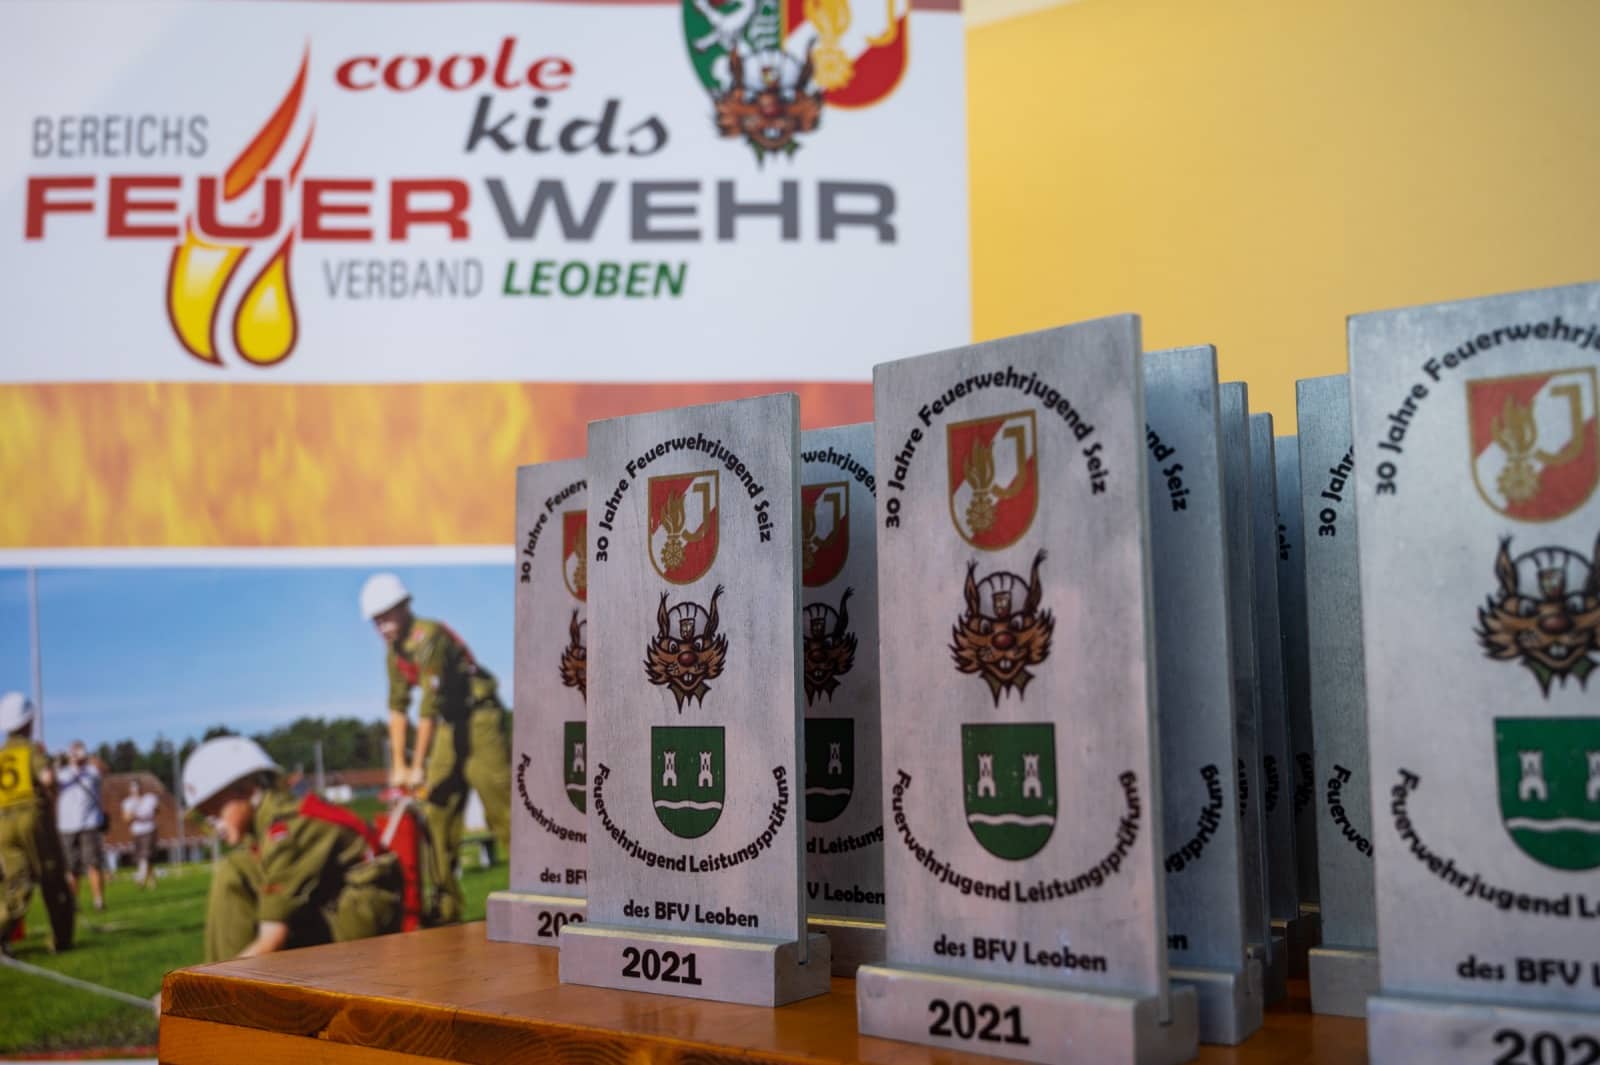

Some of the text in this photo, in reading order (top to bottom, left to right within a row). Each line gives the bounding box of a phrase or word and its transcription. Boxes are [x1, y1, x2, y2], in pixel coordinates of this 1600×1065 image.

[335, 36, 577, 93] coole
[33, 114, 209, 158] BEREICHS
[463, 95, 669, 156] kids
[24, 175, 898, 244] FEUERWEHR
[322, 259, 689, 300] VERBAND LEOBEN
[1378, 382, 1430, 454] Jahre
[886, 366, 1110, 528] 30 Jahre Feuerwehrjugend Seiz
[800, 446, 876, 498] wehrjuge
[1163, 463, 1191, 512] Seiz
[1376, 461, 1398, 496] 30
[596, 433, 775, 562] 30 Jahre Feuerwehrjugend Seiz
[1318, 507, 1337, 537] 30
[520, 479, 588, 584] 30 Jahre Feuer
[592, 763, 789, 873] Feuerwehrjugend Leistungsprüfung
[818, 825, 884, 854] Leistung
[892, 769, 1010, 902] Feuerwehrjugend
[1015, 770, 1140, 903] Leistungsprüfung
[1391, 768, 1570, 918] Feuerwehrjugend
[540, 867, 561, 884] des
[824, 882, 886, 905] Leoben
[623, 900, 760, 928] des BFV Leoben
[622, 946, 703, 986] 2021
[934, 934, 1107, 973] des BFV Leoben
[1456, 954, 1506, 982] des
[1515, 957, 1581, 987] BFV
[928, 998, 1031, 1047] 2021
[1492, 1028, 1600, 1065] 202
